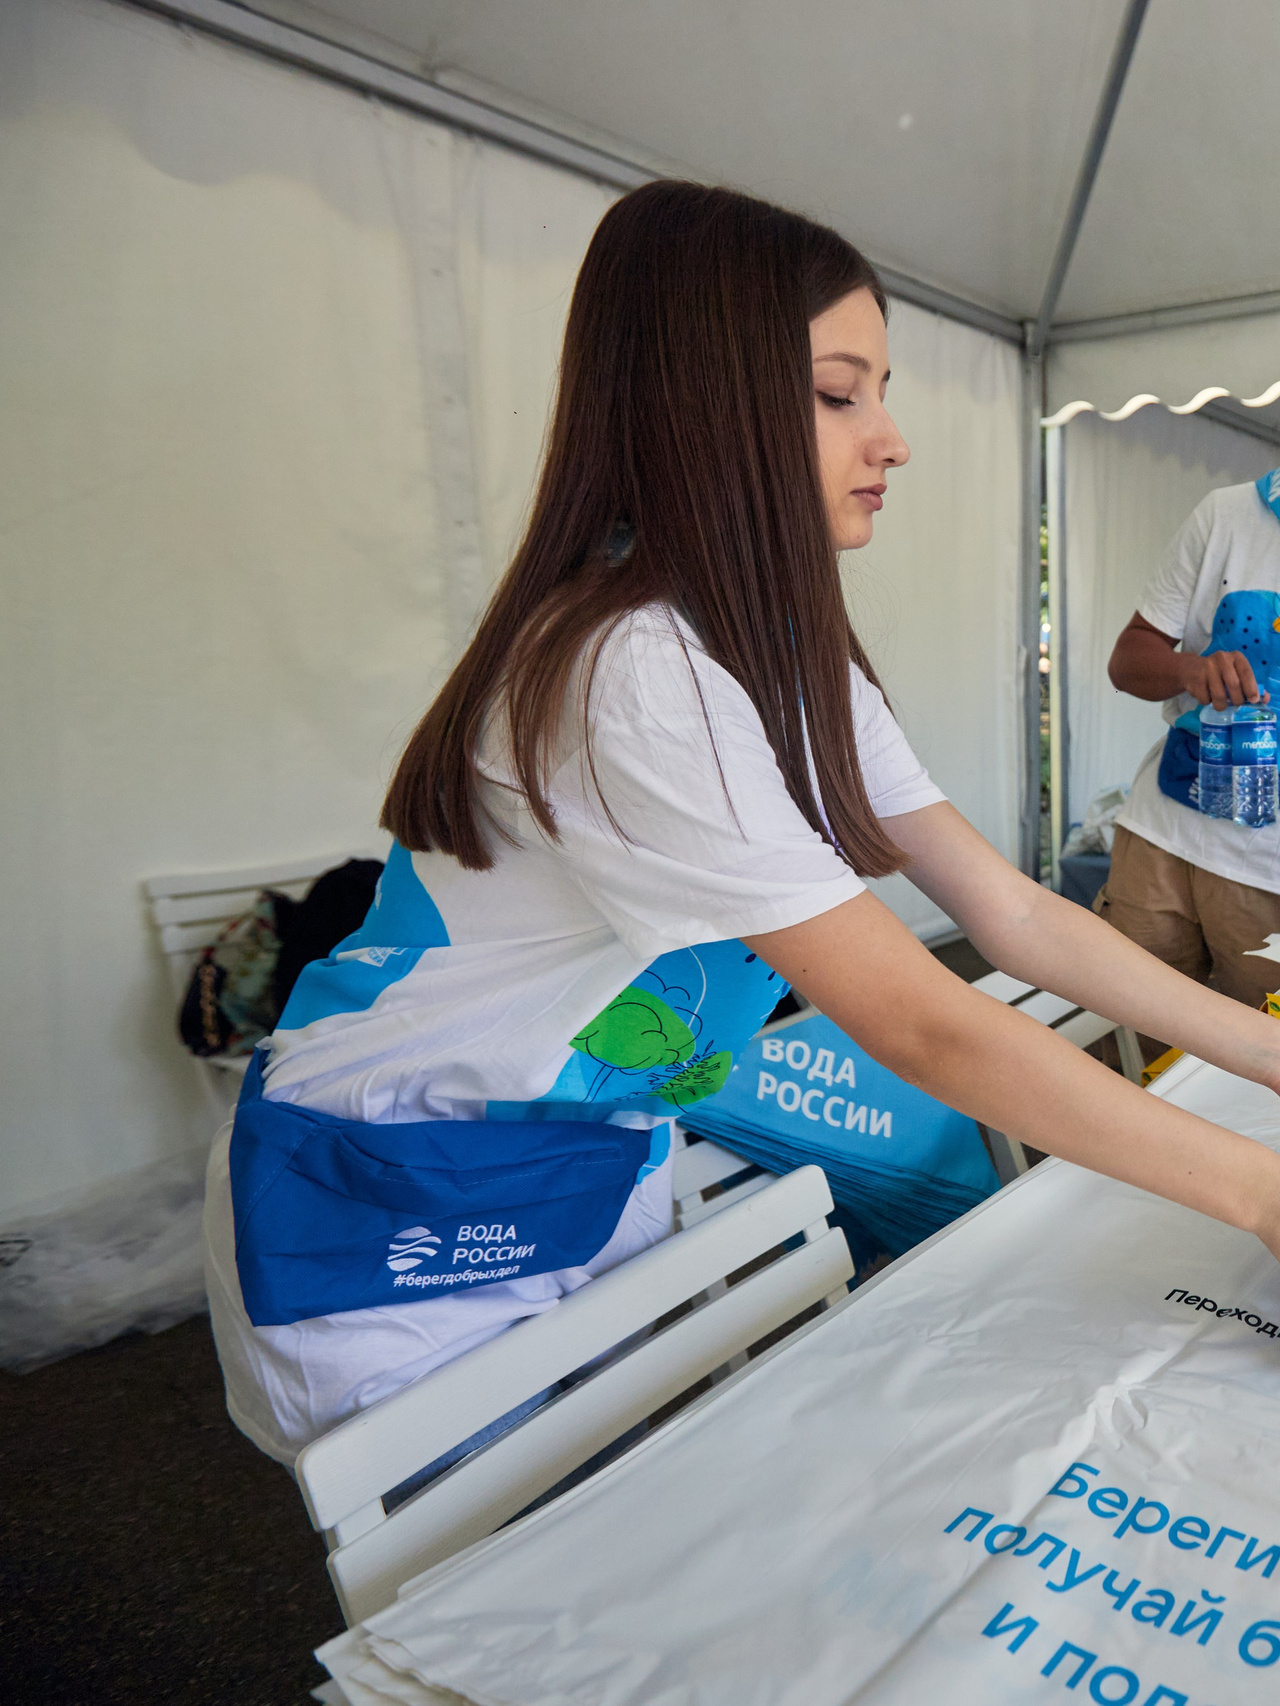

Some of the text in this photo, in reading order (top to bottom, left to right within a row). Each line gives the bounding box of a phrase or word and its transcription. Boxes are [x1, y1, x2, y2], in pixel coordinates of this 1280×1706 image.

[761, 1039, 856, 1088] ВОДА
[757, 1071, 893, 1138] РОССИИ
[452, 1244, 536, 1264] РОССИИ
[457, 1224, 517, 1243] ВОДА
[393, 1265, 520, 1288] #берегдобрыхдел
[944, 1507, 1227, 1646] получай
[981, 1602, 1039, 1655] и
